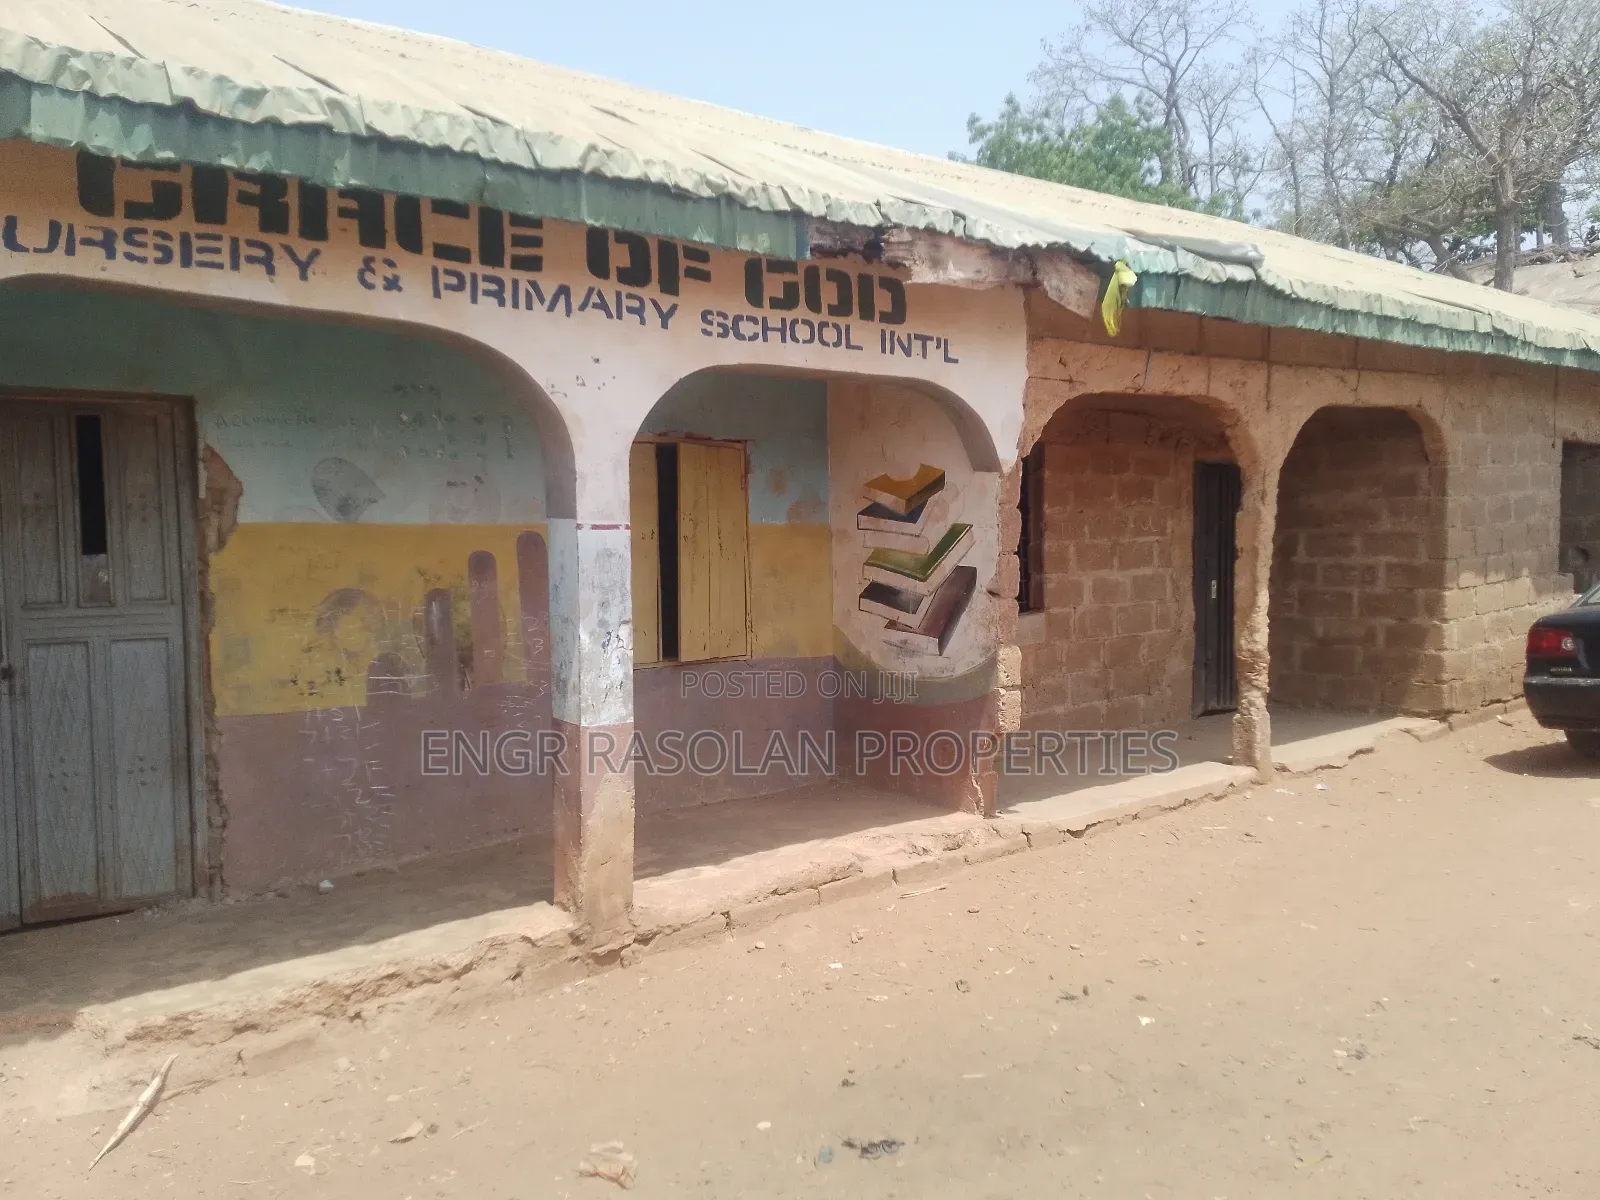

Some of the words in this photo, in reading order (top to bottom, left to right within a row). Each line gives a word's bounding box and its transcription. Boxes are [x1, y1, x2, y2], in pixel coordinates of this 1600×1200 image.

[2, 215, 321, 281] URSERY
[357, 256, 404, 292] &
[431, 265, 679, 331] PRIMARY
[701, 309, 863, 351] SCHOOL
[880, 328, 959, 364] INT'L
[76, 151, 543, 271] GRACE
[586, 226, 712, 297] OF
[744, 257, 907, 325] GOD
